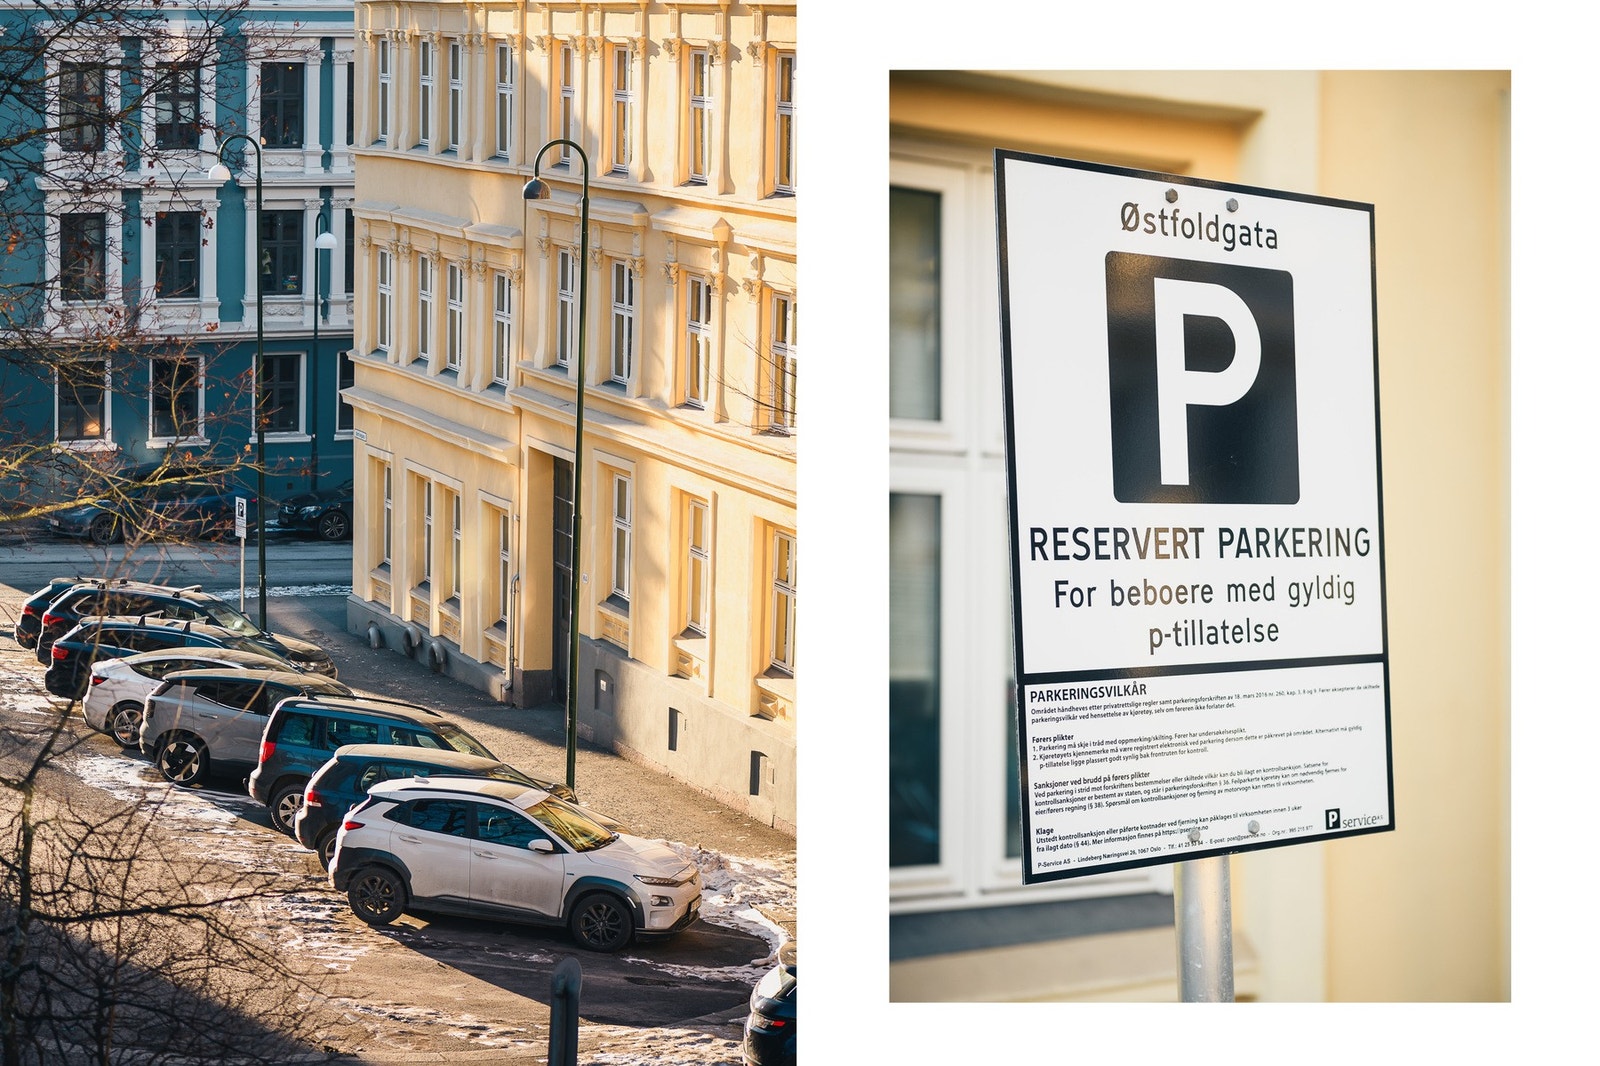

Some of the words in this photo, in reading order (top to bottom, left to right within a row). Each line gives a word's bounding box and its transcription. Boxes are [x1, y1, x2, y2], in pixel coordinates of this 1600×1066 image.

[1121, 202, 1278, 251] Østfoldgata
[1154, 277, 1262, 486] P
[1030, 527, 1204, 561] RESERVERT
[1219, 527, 1370, 558] PARKERING
[1055, 580, 1096, 608] For
[1111, 579, 1213, 606] beboere
[1227, 576, 1274, 602] med
[1289, 575, 1354, 607] gyldig
[1150, 618, 1278, 655] p-tillatelse
[1030, 682, 1147, 703] PARKERINGSVILKÅR
[1031, 707, 1056, 715] Området
[1057, 705, 1088, 713] håndheves
[1103, 701, 1142, 711] privatrettslige
[1142, 700, 1158, 708] regler
[1173, 695, 1227, 706] parkeringsforskriften
[1031, 714, 1078, 725] parkeringsvilkår
[1090, 711, 1122, 719] hensettelse
[1130, 709, 1153, 717] kjøretøy,
[1053, 734, 1074, 743] plikter
[1077, 741, 1089, 749] skje
[1092, 739, 1104, 747] tråd
[1039, 752, 1072, 761] Kjøretøyets
[1073, 748, 1109, 758] kjennemerke
[1134, 744, 1159, 752] registrert
[1159, 740, 1188, 749] elektronisk
[1039, 760, 1070, 770] p-tillatelse
[1070, 759, 1085, 767] ligge
[1086, 757, 1108, 766] plassert
[1108, 755, 1122, 763] godt
[1122, 753, 1139, 762] synlig
[1150, 750, 1178, 758] frontruten
[1034, 780, 1069, 790] Sanksjoner
[1070, 777, 1082, 786] ved
[1083, 775, 1102, 784] brudd
[1103, 774, 1111, 784] på
[1130, 771, 1150, 781] plikter
[1046, 789, 1074, 798] parkering
[1077, 786, 1090, 794] strid
[1103, 782, 1134, 791] forskriftens
[1134, 778, 1171, 787] bestemmelser
[1184, 774, 1204, 782] skiltede
[1035, 796, 1087, 807] kontrollsanksjoner
[1094, 792, 1116, 800] bestemt
[1151, 786, 1161, 794] står
[1165, 781, 1218, 793] parkeringsforskriften
[1035, 807, 1064, 816] eier/førers
[1065, 804, 1087, 813] regning
[1105, 798, 1130, 808] Spørsmål
[1140, 793, 1188, 803] kontrollsanksjoner
[1197, 789, 1216, 797] fjerning
[1329, 811, 1338, 828] P
[1342, 814, 1377, 828] service
[1036, 835, 1058, 844] Utstedt
[1058, 830, 1105, 841] kontrollsanksjon
[1119, 826, 1139, 835] påførte
[1140, 822, 1167, 830] kostnader
[1178, 818, 1198, 827] fjerning
[1036, 827, 1054, 836] Klage
[1046, 844, 1059, 852] ilagt
[1059, 842, 1073, 850] dato
[1104, 834, 1137, 843] informasjon
[1154, 830, 1161, 838] på
[1162, 825, 1209, 836] https://pserce.no
[1038, 860, 1062, 868] P-Service
[1077, 855, 1102, 863] Lindeberg
[1103, 850, 1129, 859] Næringsvei
